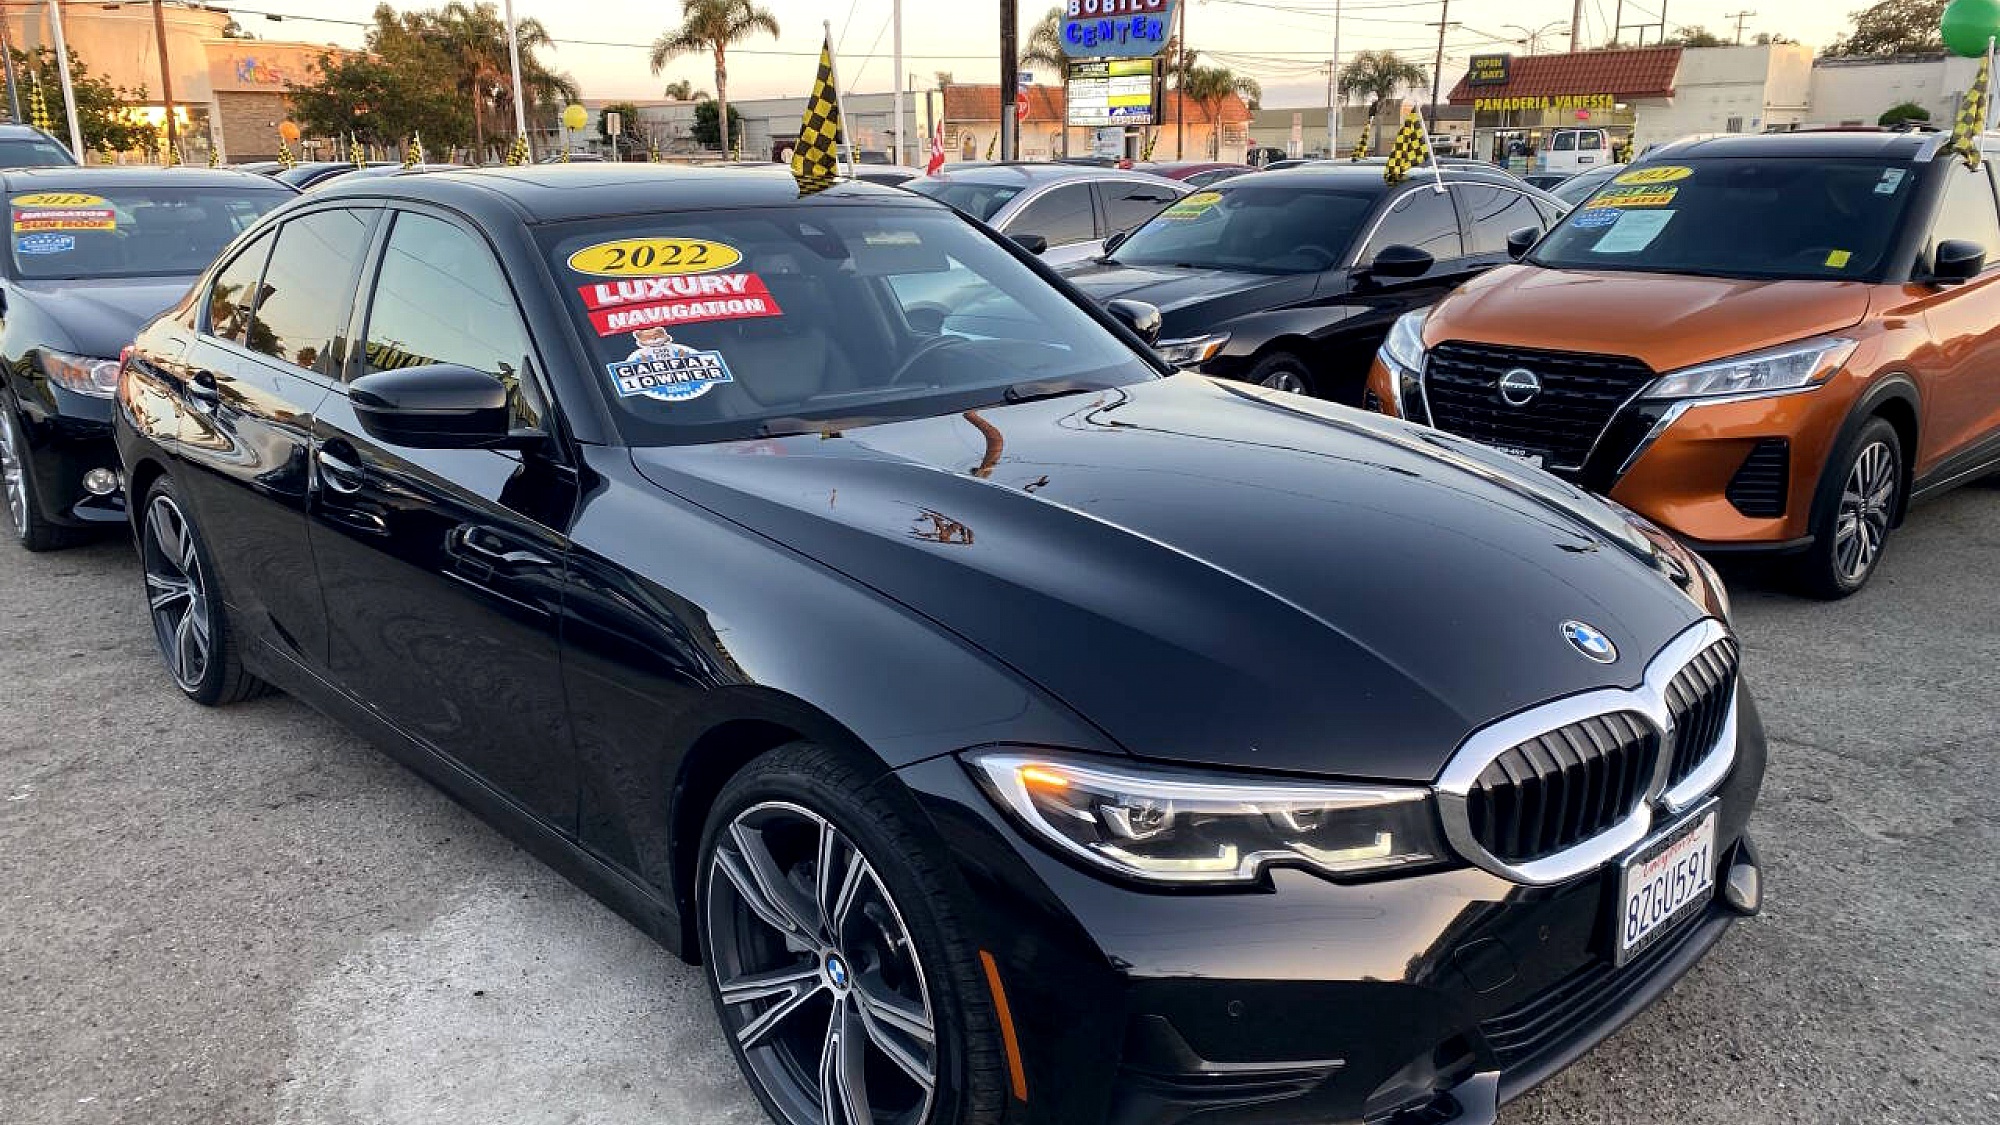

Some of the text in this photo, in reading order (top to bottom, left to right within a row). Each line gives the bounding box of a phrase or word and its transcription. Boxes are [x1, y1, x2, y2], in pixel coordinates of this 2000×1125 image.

[1066, 15, 1163, 47] CENTER
[1476, 58, 1502, 67] OPEN
[1481, 69, 1504, 79] DAYS
[1474, 94, 1613, 111] PANADERIA VANESSA
[21, 211, 108, 219] NAVIGATION
[602, 244, 709, 271] 2022
[594, 274, 748, 304] LUXURY
[607, 299, 766, 328] NAVIGATION
[619, 357, 716, 377] CARFAX
[642, 368, 725, 387] OWNER
[1627, 843, 1708, 943] 8ZGU591
